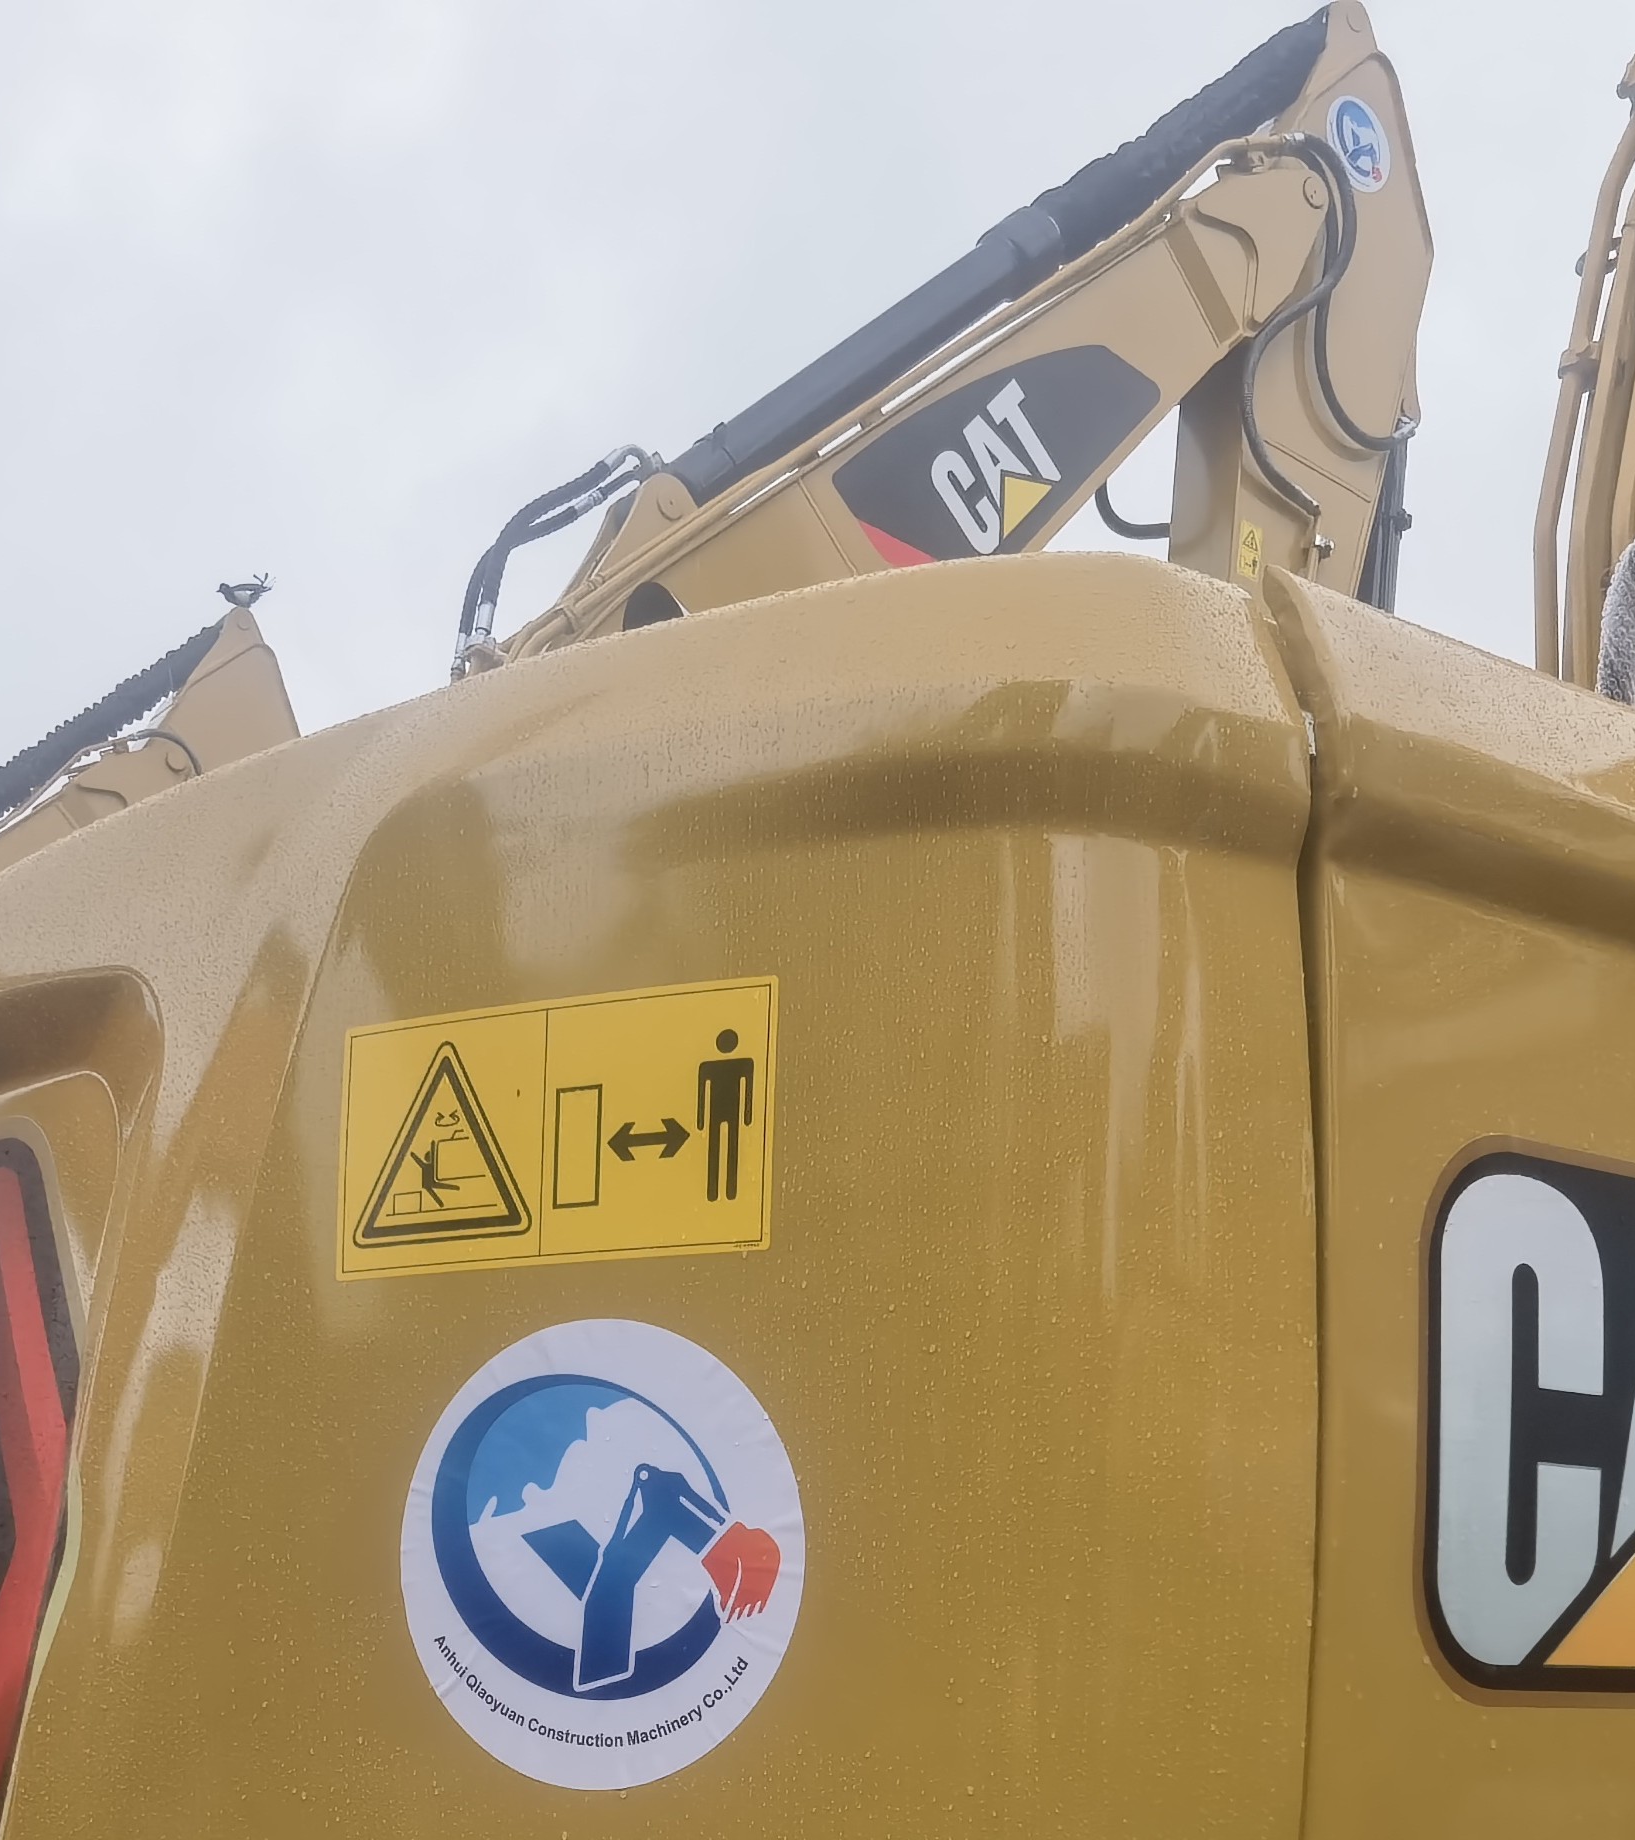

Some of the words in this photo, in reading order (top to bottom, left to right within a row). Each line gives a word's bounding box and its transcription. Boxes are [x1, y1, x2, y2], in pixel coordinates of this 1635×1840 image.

[931, 378, 1062, 555] CAT
[433, 1635, 468, 1678] Anhui
[465, 1674, 525, 1727] Qiaoyuan
[527, 1718, 624, 1748] Construction
[626, 1705, 703, 1746] Machinery
